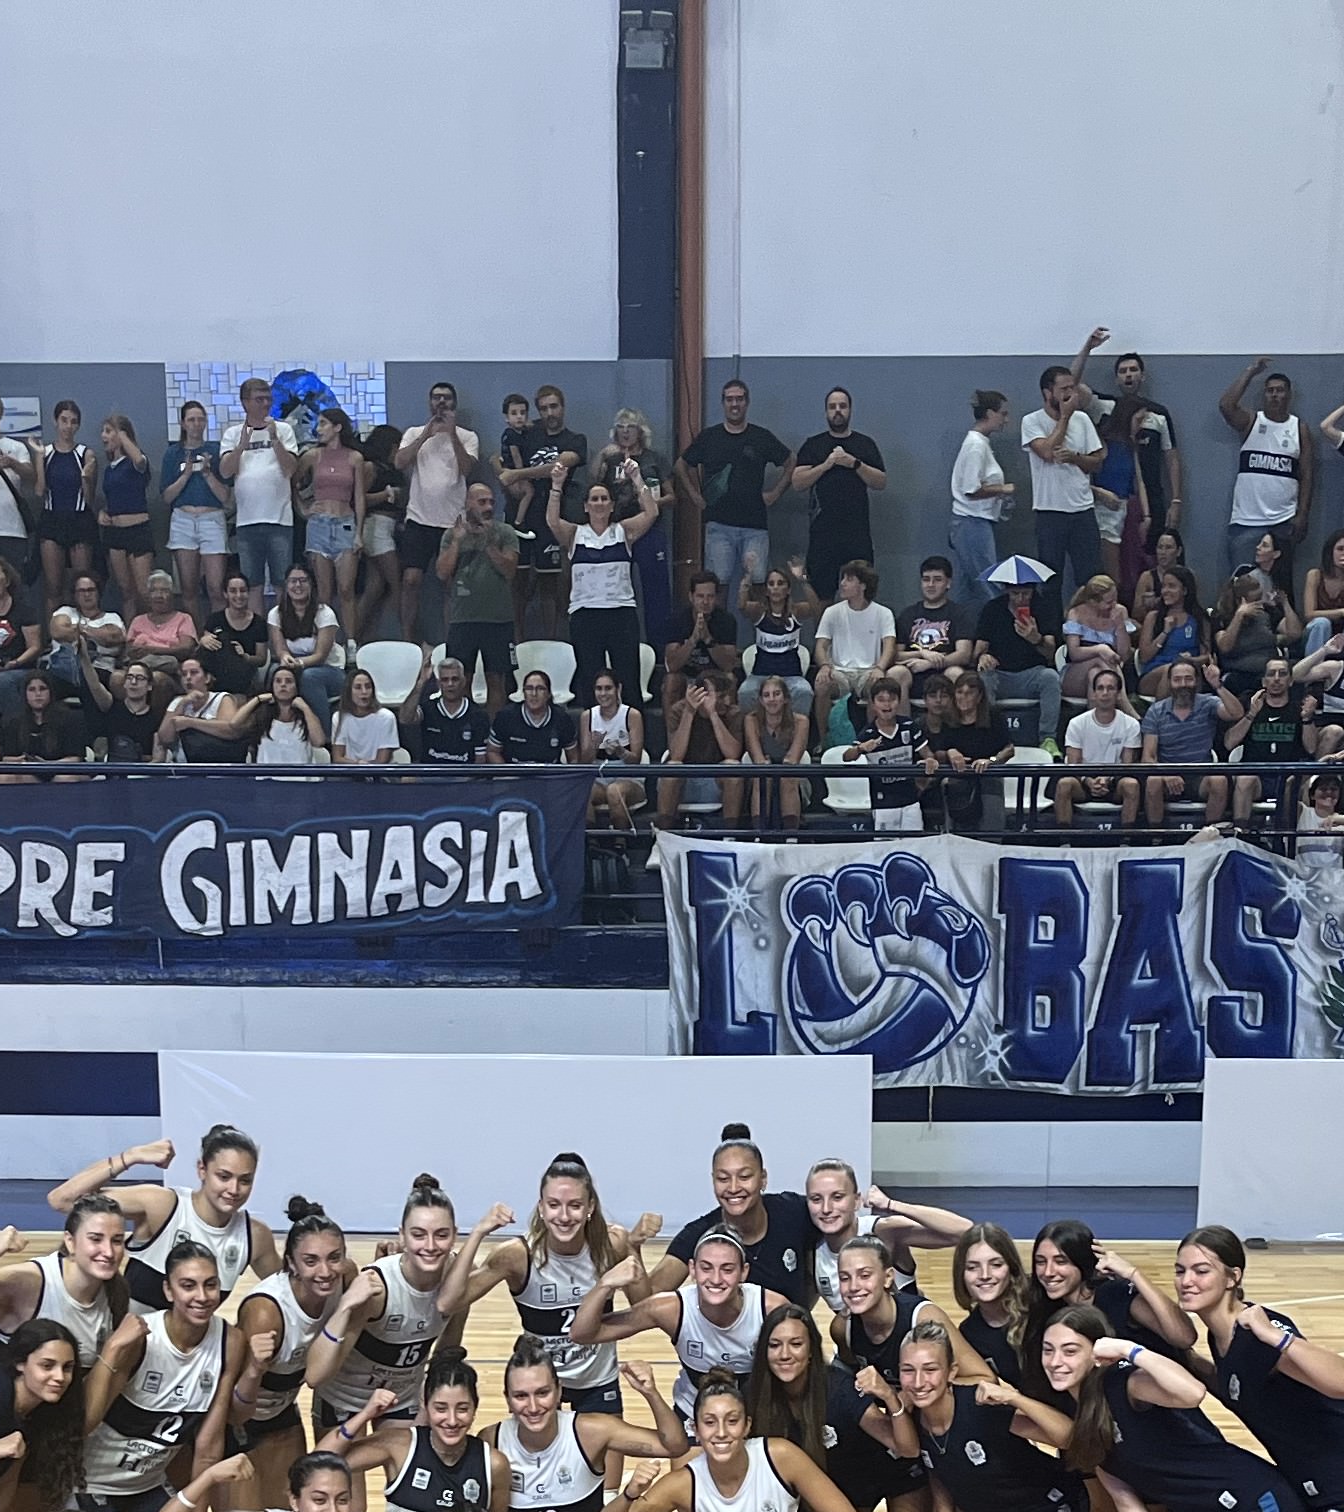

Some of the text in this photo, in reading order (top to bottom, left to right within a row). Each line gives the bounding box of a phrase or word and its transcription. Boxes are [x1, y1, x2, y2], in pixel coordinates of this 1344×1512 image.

[1006, 717, 1020, 729] 16
[159, 808, 544, 936] GIMNASIA
[394, 1343, 423, 1367] 15
[151, 1414, 184, 1443] 12
